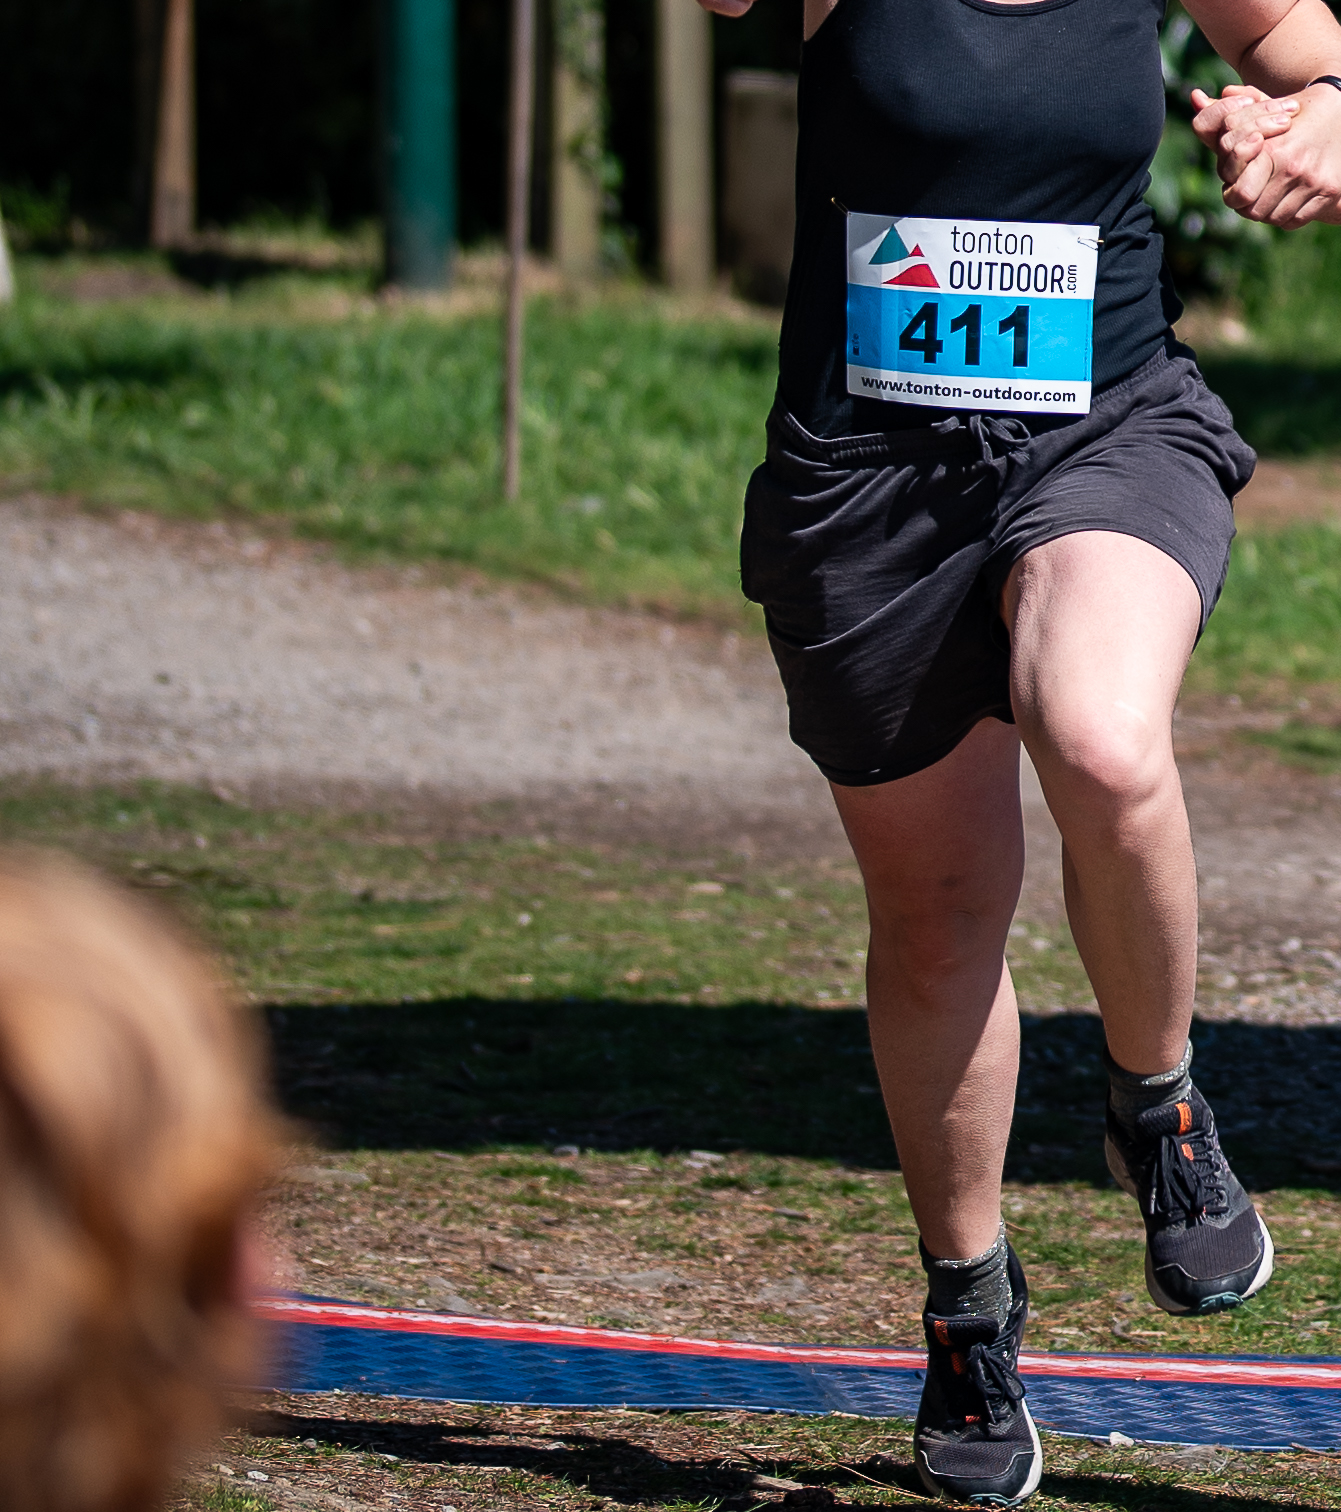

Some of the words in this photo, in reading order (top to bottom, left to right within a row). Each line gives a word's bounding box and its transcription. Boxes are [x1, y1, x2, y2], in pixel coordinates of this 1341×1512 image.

[950, 225, 1033, 256] tonton
[949, 260, 1065, 294] OUTDOOR
[898, 301, 1030, 368] 411
[861, 376, 1076, 403] www.tonton-outdoor.com
